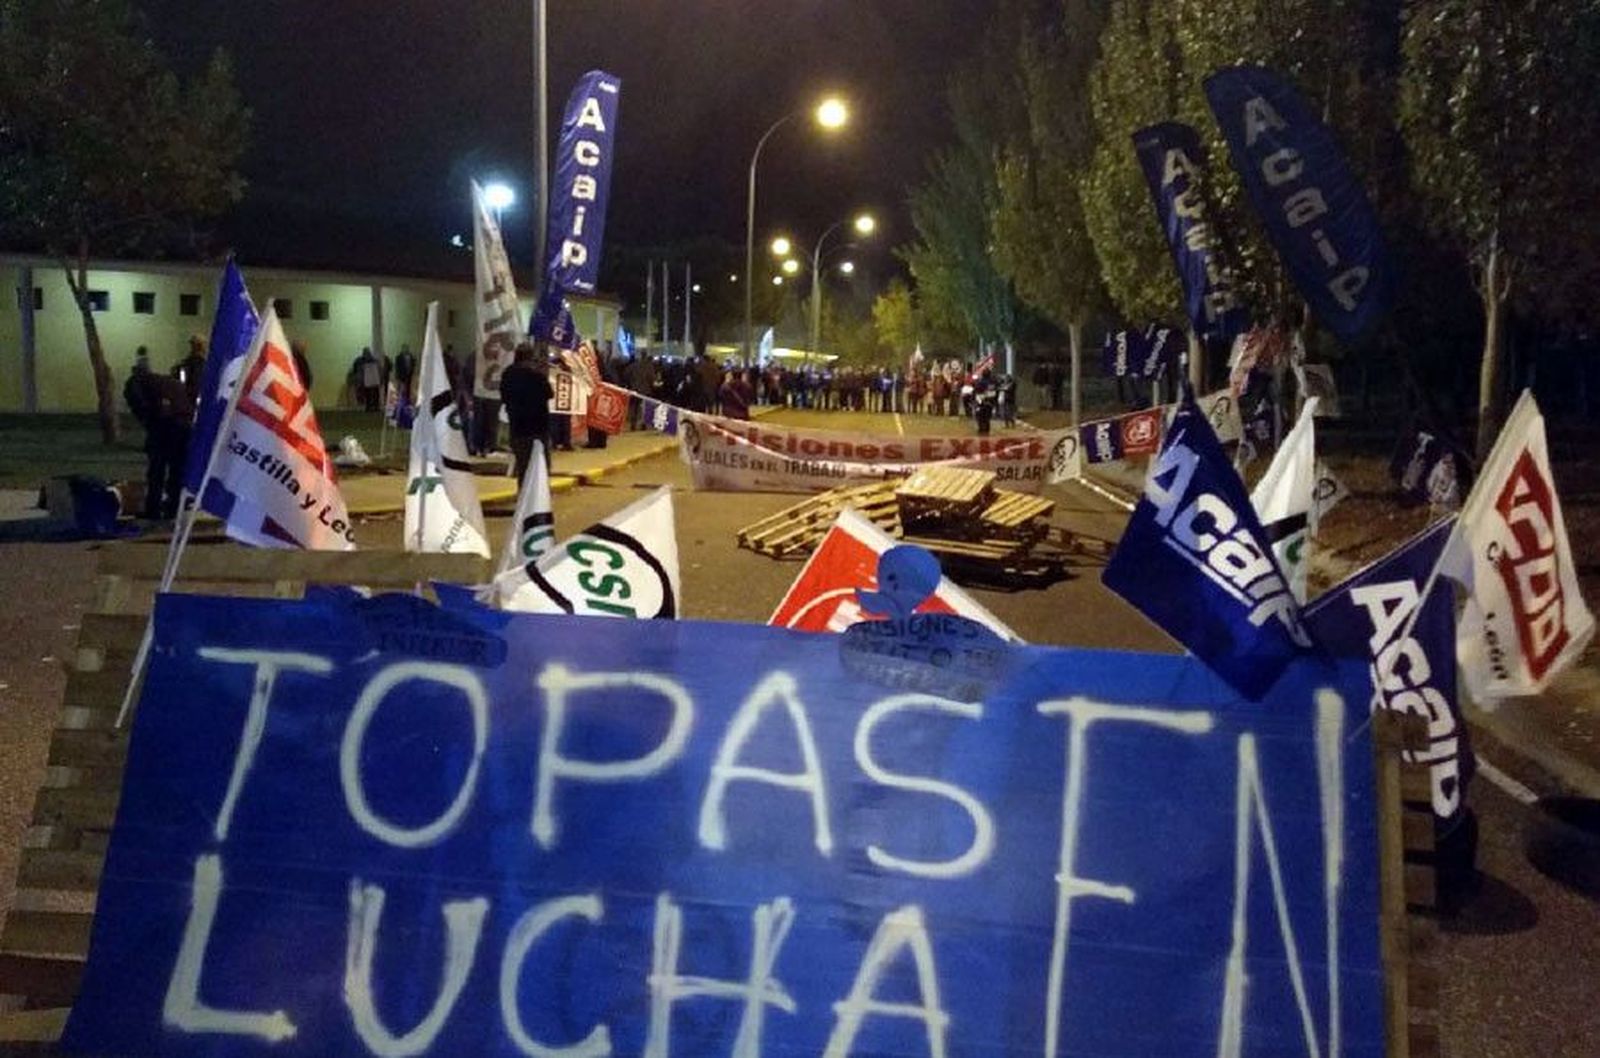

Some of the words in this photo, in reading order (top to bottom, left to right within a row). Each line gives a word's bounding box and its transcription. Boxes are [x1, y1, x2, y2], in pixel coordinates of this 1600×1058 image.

[561, 97, 605, 268] Acaip
[1244, 97, 1370, 311] Acaip
[299, 493, 317, 510] y
[196, 646, 995, 879] TOPAS
[161, 853, 951, 1058] LUCHA
